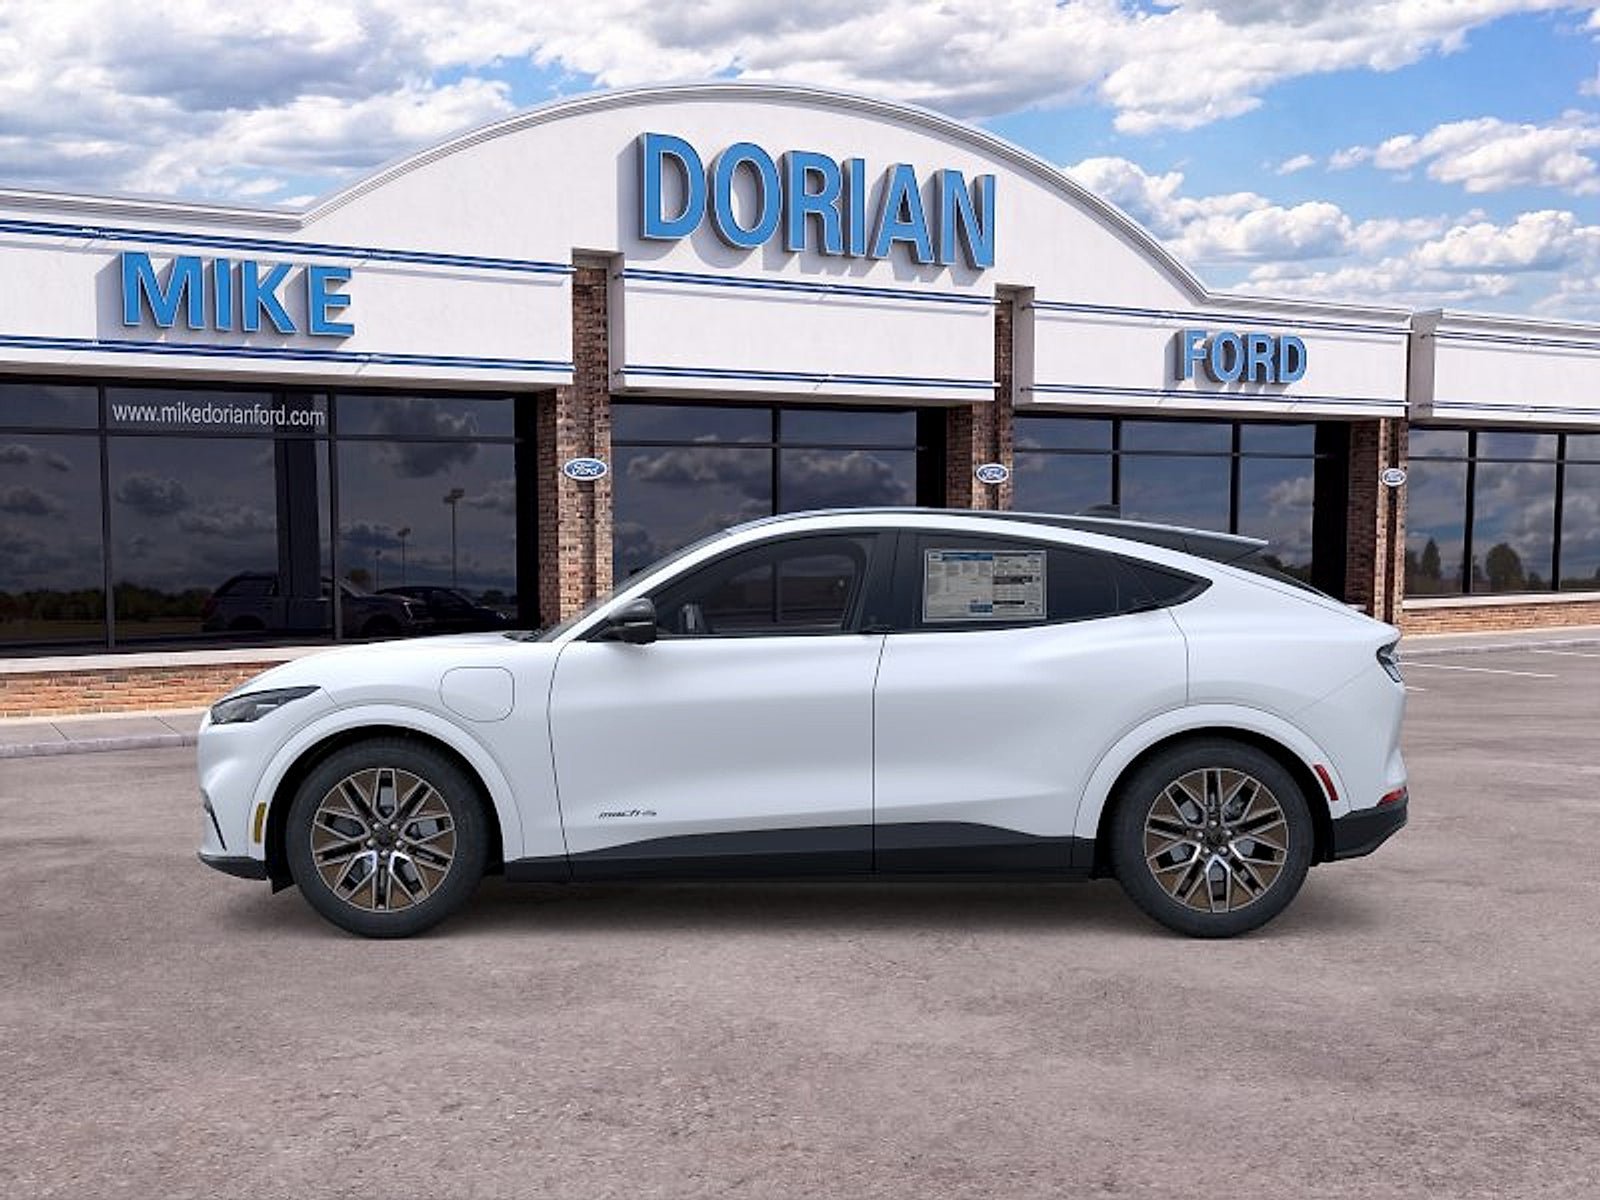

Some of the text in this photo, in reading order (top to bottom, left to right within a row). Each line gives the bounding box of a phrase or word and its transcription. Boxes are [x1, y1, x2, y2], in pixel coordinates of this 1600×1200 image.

[640, 132, 995, 269] DORIAN
[122, 251, 355, 337] MIKE
[1177, 329, 1308, 384] FORD
[112, 402, 325, 426] www.mikedorianford.com
[572, 461, 600, 476] Ford
